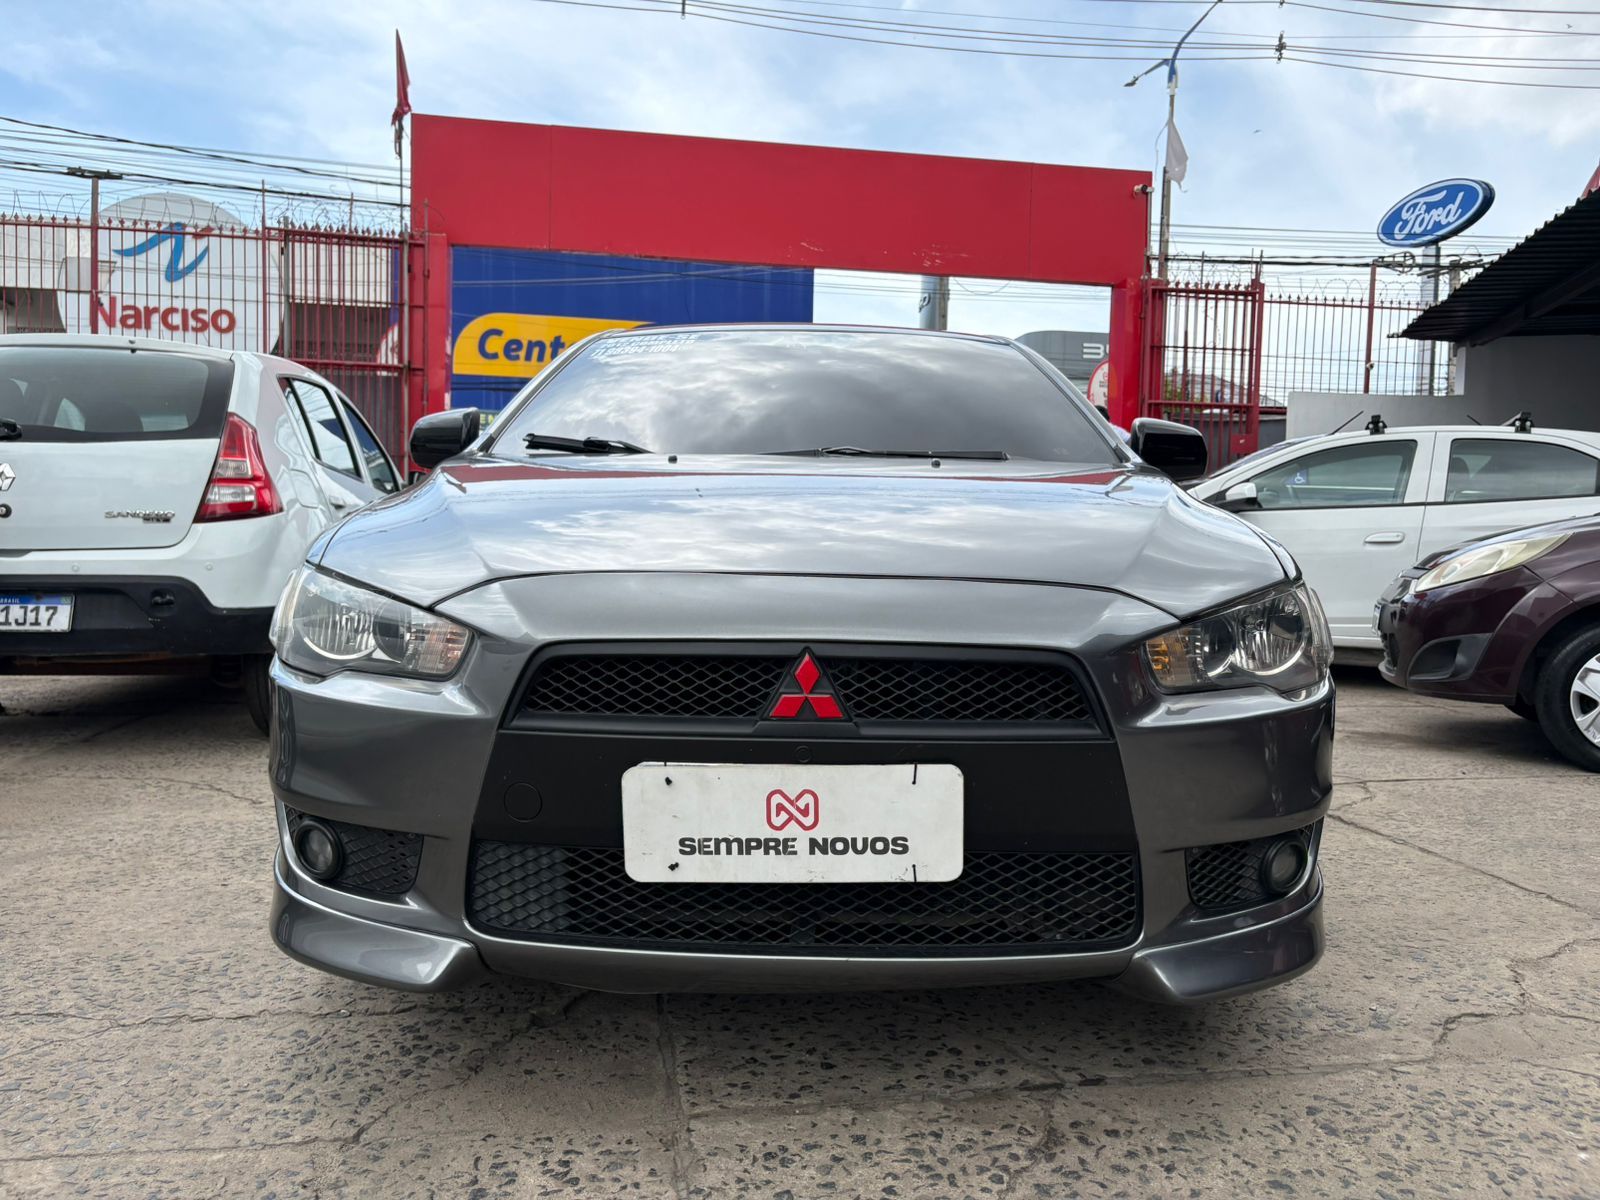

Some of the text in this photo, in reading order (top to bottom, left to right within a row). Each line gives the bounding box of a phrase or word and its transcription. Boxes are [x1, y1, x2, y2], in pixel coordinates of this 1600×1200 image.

[1394, 189, 1464, 240] Ford
[90, 295, 236, 334] Narciso
[478, 328, 576, 363] Cent
[678, 836, 798, 856] SEMPRE
